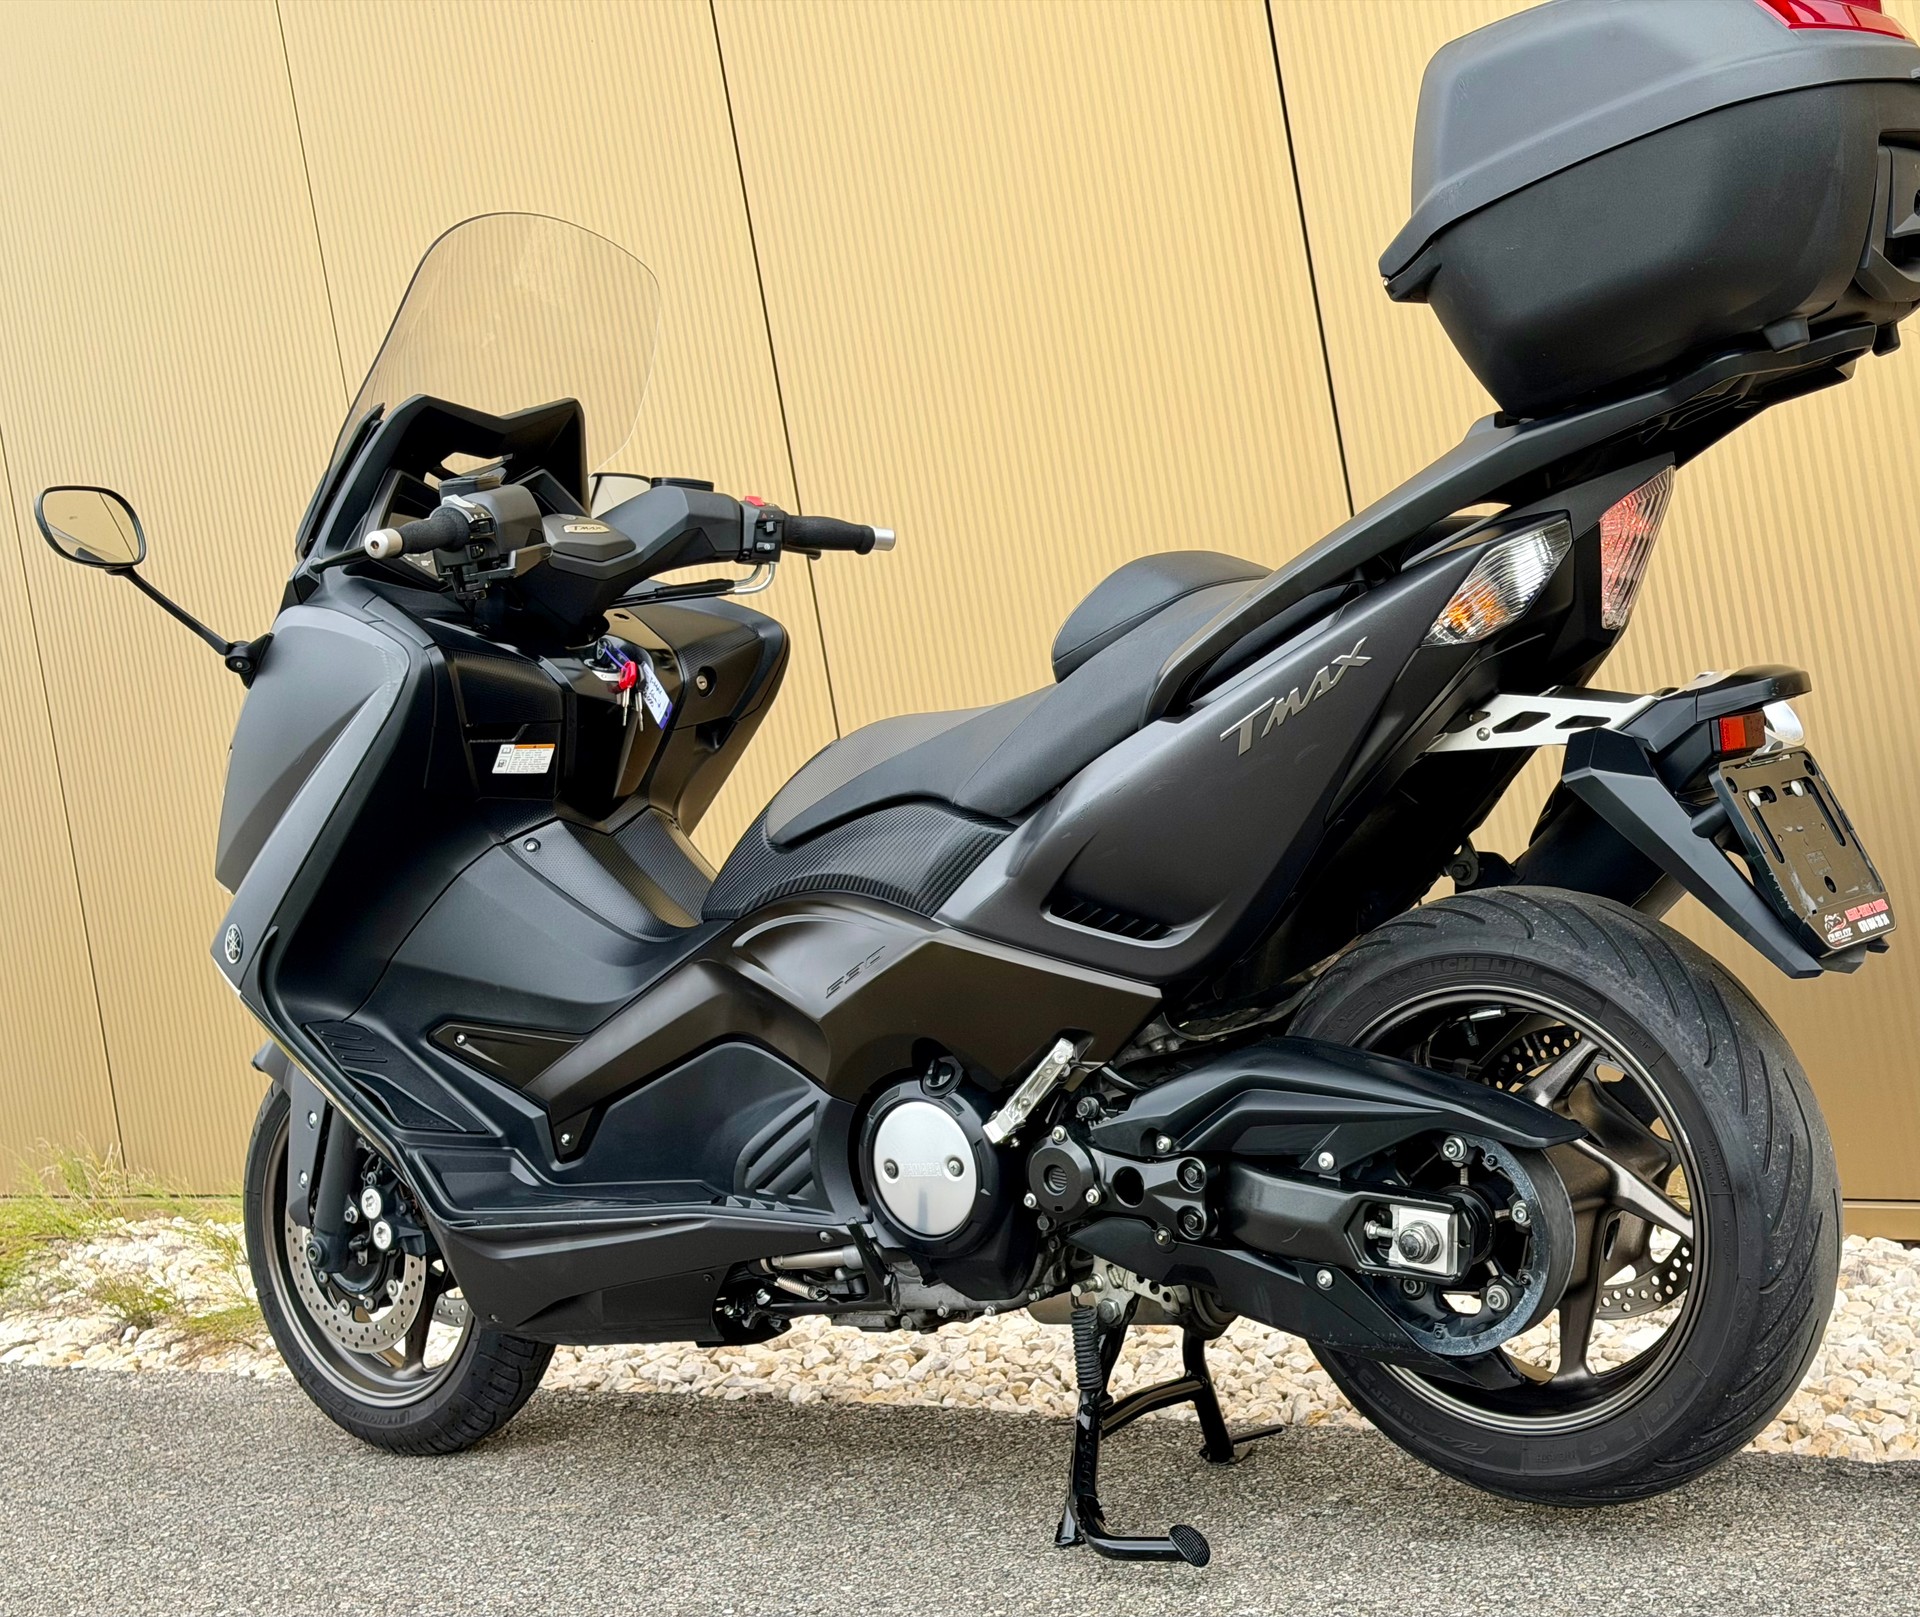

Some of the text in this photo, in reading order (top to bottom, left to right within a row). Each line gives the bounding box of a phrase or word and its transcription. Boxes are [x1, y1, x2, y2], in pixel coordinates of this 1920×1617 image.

[1219, 635, 1374, 758] TMAX
[1408, 957, 1536, 979] MICHELIN
[903, 1162, 943, 1177] YAMAHA
